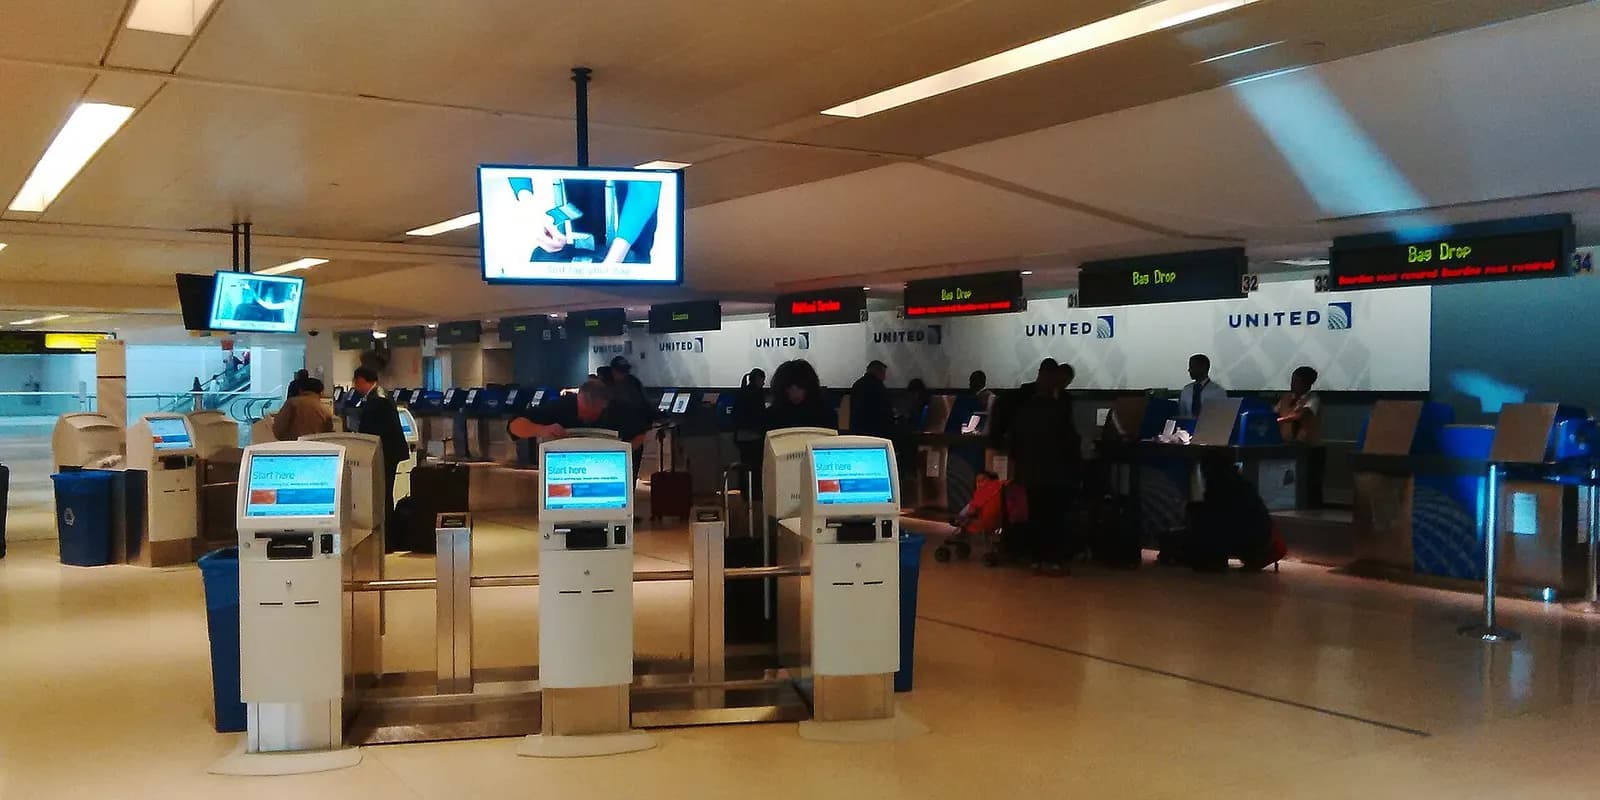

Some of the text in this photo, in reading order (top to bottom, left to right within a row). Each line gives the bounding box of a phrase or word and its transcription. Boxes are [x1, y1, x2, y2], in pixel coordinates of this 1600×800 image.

[1408, 242, 1472, 263] Bag Drop
[1574, 253, 1592, 273] 34
[1133, 269, 1176, 285] Bag Drop
[1243, 275, 1258, 291] 32
[1314, 275, 1328, 292] 33
[956, 287, 972, 299] Drop
[1228, 310, 1321, 329] UNITED
[1026, 322, 1092, 337] UNITED
[755, 337, 796, 348] UNITED
[873, 330, 925, 344] UNITED
[659, 341, 693, 352] UNITED
[548, 466, 587, 475] Start here
[816, 463, 851, 471] Start here
[253, 471, 296, 480] Start here
